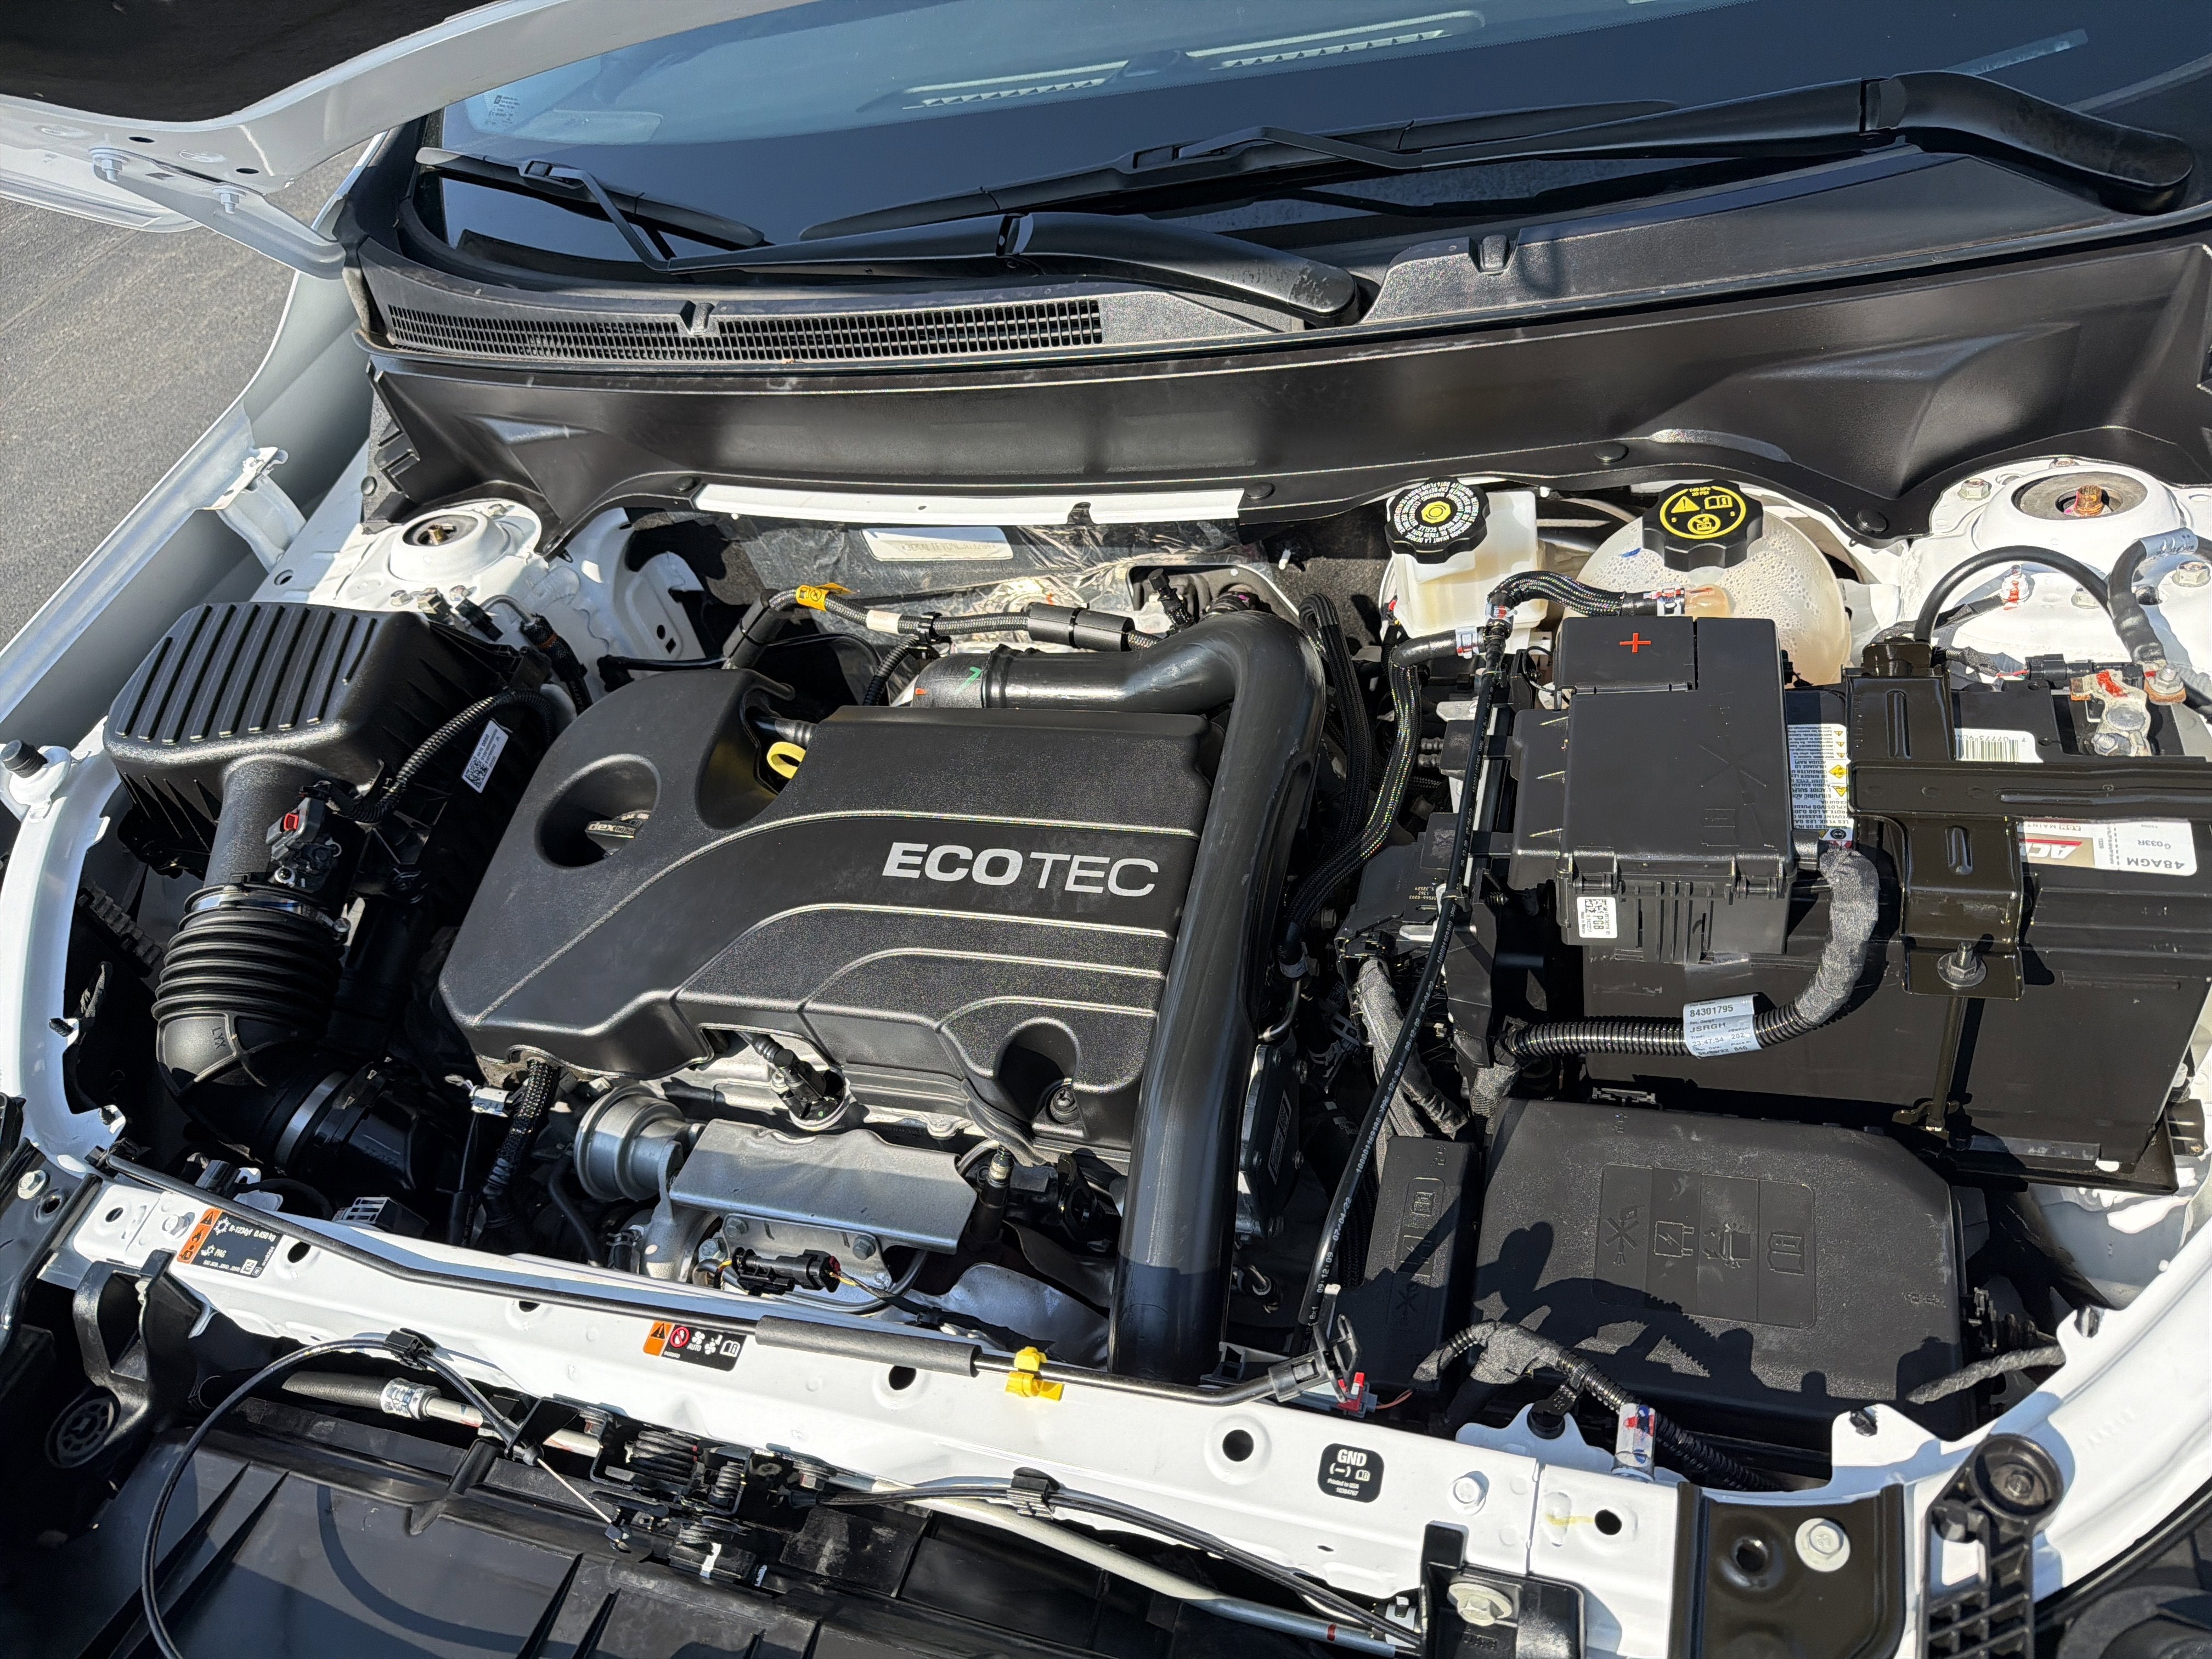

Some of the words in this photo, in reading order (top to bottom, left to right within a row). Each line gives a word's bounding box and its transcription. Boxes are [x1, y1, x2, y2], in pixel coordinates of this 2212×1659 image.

[1408, 487, 1421, 497] FROM
[1419, 487, 1437, 496] BEFORE
[1395, 499, 1407, 513] SEALED
[1438, 521, 1455, 531] BIDON
[1448, 520, 1467, 533] LIQUIDE
[1450, 522, 1472, 538] BOUCHON
[588, 822, 636, 834] dexos
[882, 842, 1159, 897] ECOTEC
[2126, 857, 2185, 870] 48AGM
[1592, 915, 1604, 929] PGB
[1690, 1005, 1734, 1018] 84301795
[1690, 1022, 1726, 1033] JSRGH
[211, 1026, 226, 1049] LYX
[1692, 1036, 1724, 1047] 23:47:54
[1331, 1195, 1353, 1243] 07/04/22
[228, 1224, 253, 1237] R-1234yf
[253, 1229, 268, 1239] 0.450
[268, 1233, 277, 1242] kg
[214, 1248, 227, 1258] PAG
[686, 1342, 702, 1352] AUTO
[1338, 1449, 1367, 1466] GND
